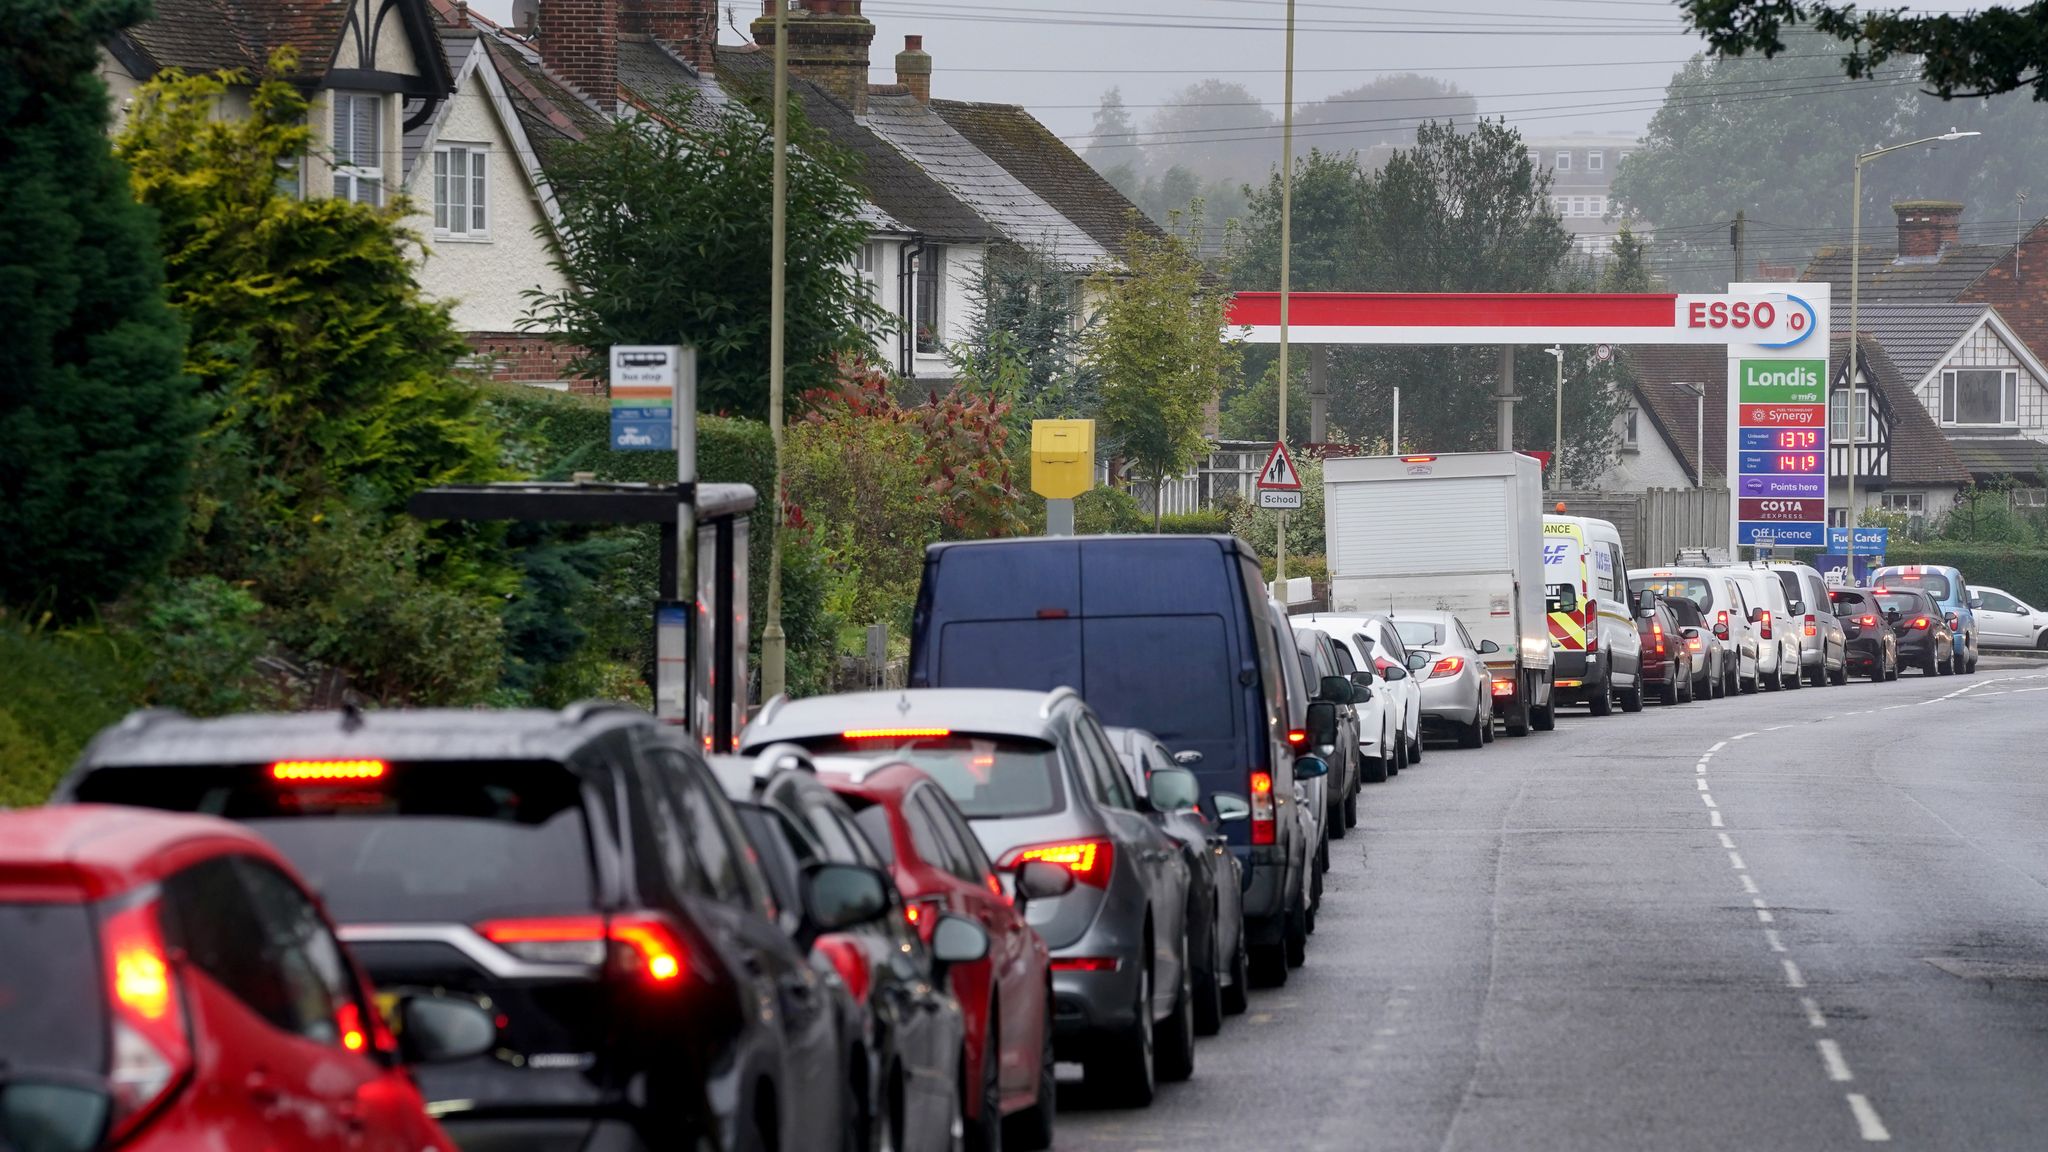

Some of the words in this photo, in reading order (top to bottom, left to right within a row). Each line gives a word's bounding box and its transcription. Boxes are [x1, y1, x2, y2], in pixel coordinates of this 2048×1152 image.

[1689, 301, 1775, 329] ESSO
[1747, 367, 1817, 386] Londis
[1769, 410, 1813, 423] Synergy
[1771, 483, 1797, 491] Points
[1799, 483, 1818, 491] here
[1264, 495, 1297, 504] School
[1760, 501, 1803, 512] COSTA
[1751, 528, 1769, 538] Off
[1771, 528, 1812, 539] Licence
[1855, 533, 1882, 543] Cards
